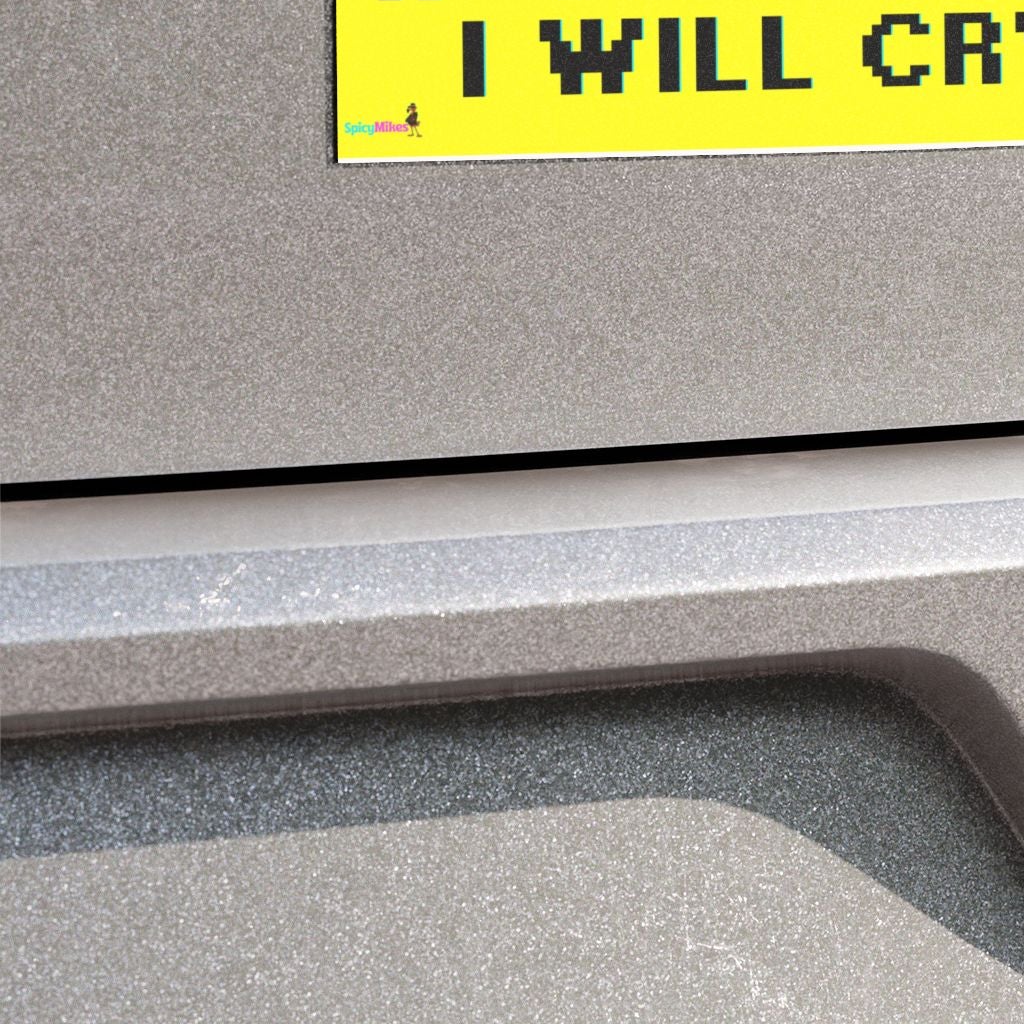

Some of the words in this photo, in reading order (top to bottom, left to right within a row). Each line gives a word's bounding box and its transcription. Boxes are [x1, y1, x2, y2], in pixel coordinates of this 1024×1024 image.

[462, 21, 486, 97] I
[539, 16, 813, 94] WILL
[344, 121, 409, 136] SpicyMikes
